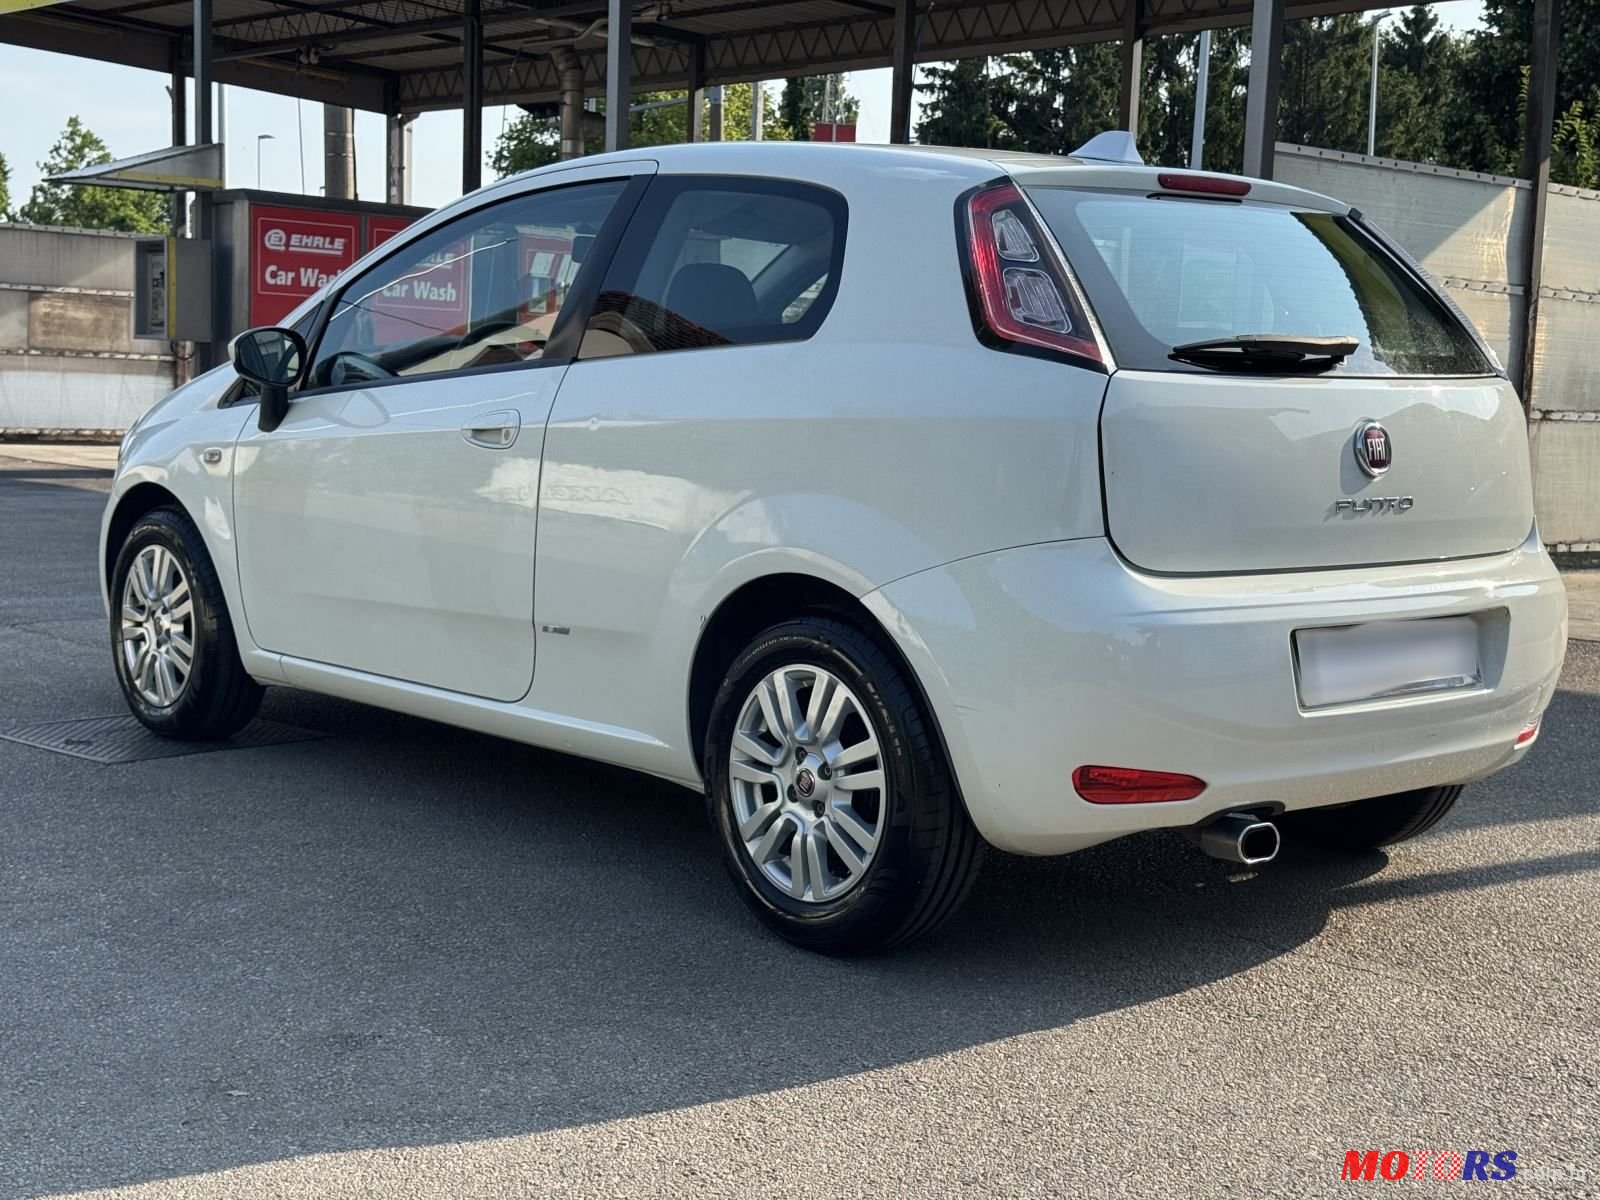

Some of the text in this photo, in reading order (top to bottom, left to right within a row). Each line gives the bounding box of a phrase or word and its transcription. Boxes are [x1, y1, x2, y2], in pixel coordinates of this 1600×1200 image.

[289, 233, 345, 250] EHRLE
[264, 264, 296, 286] Car
[413, 280, 456, 302] Wash
[1366, 437, 1386, 461] FIAT
[1335, 495, 1414, 513] PUNTO
